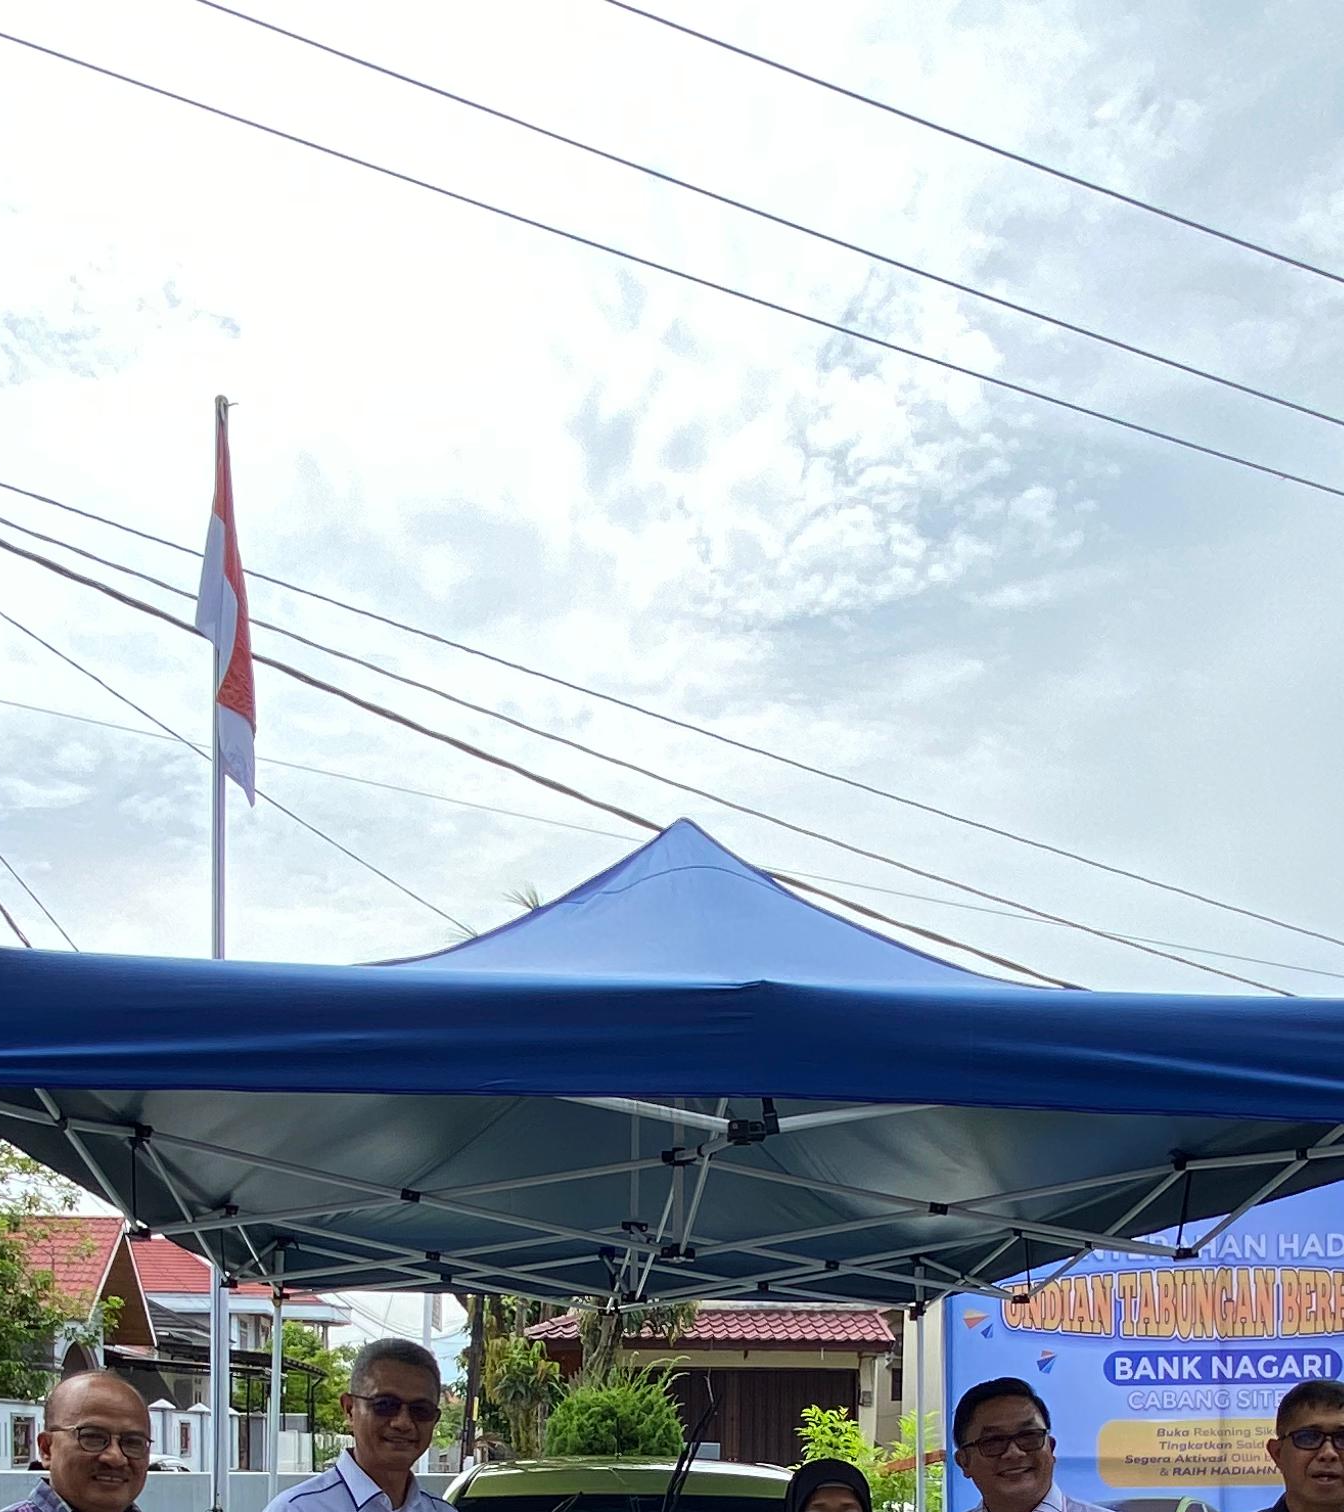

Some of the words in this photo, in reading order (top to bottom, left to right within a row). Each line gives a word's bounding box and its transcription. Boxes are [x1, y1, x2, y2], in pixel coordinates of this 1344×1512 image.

[1005, 1274, 1115, 1335] UNDIAN
[1118, 1267, 1276, 1338] TABUNGAN
[1114, 1356, 1203, 1380] BANK
[1211, 1354, 1332, 1379] NAGARI
[1128, 1389, 1231, 1410] CABANG
[1236, 1388, 1285, 1409] SITE
[1156, 1428, 1190, 1437] Buka
[1194, 1427, 1252, 1439] Rekening
[1255, 1427, 1274, 1437] Sik
[1159, 1441, 1233, 1452] Tingkatkan
[1236, 1441, 1265, 1450] Sald
[1124, 1455, 1171, 1466] Segera
[1174, 1454, 1227, 1464] Aktivasi
[1172, 1466, 1207, 1476] RAIH
[1210, 1466, 1278, 1476] HADIAHN
